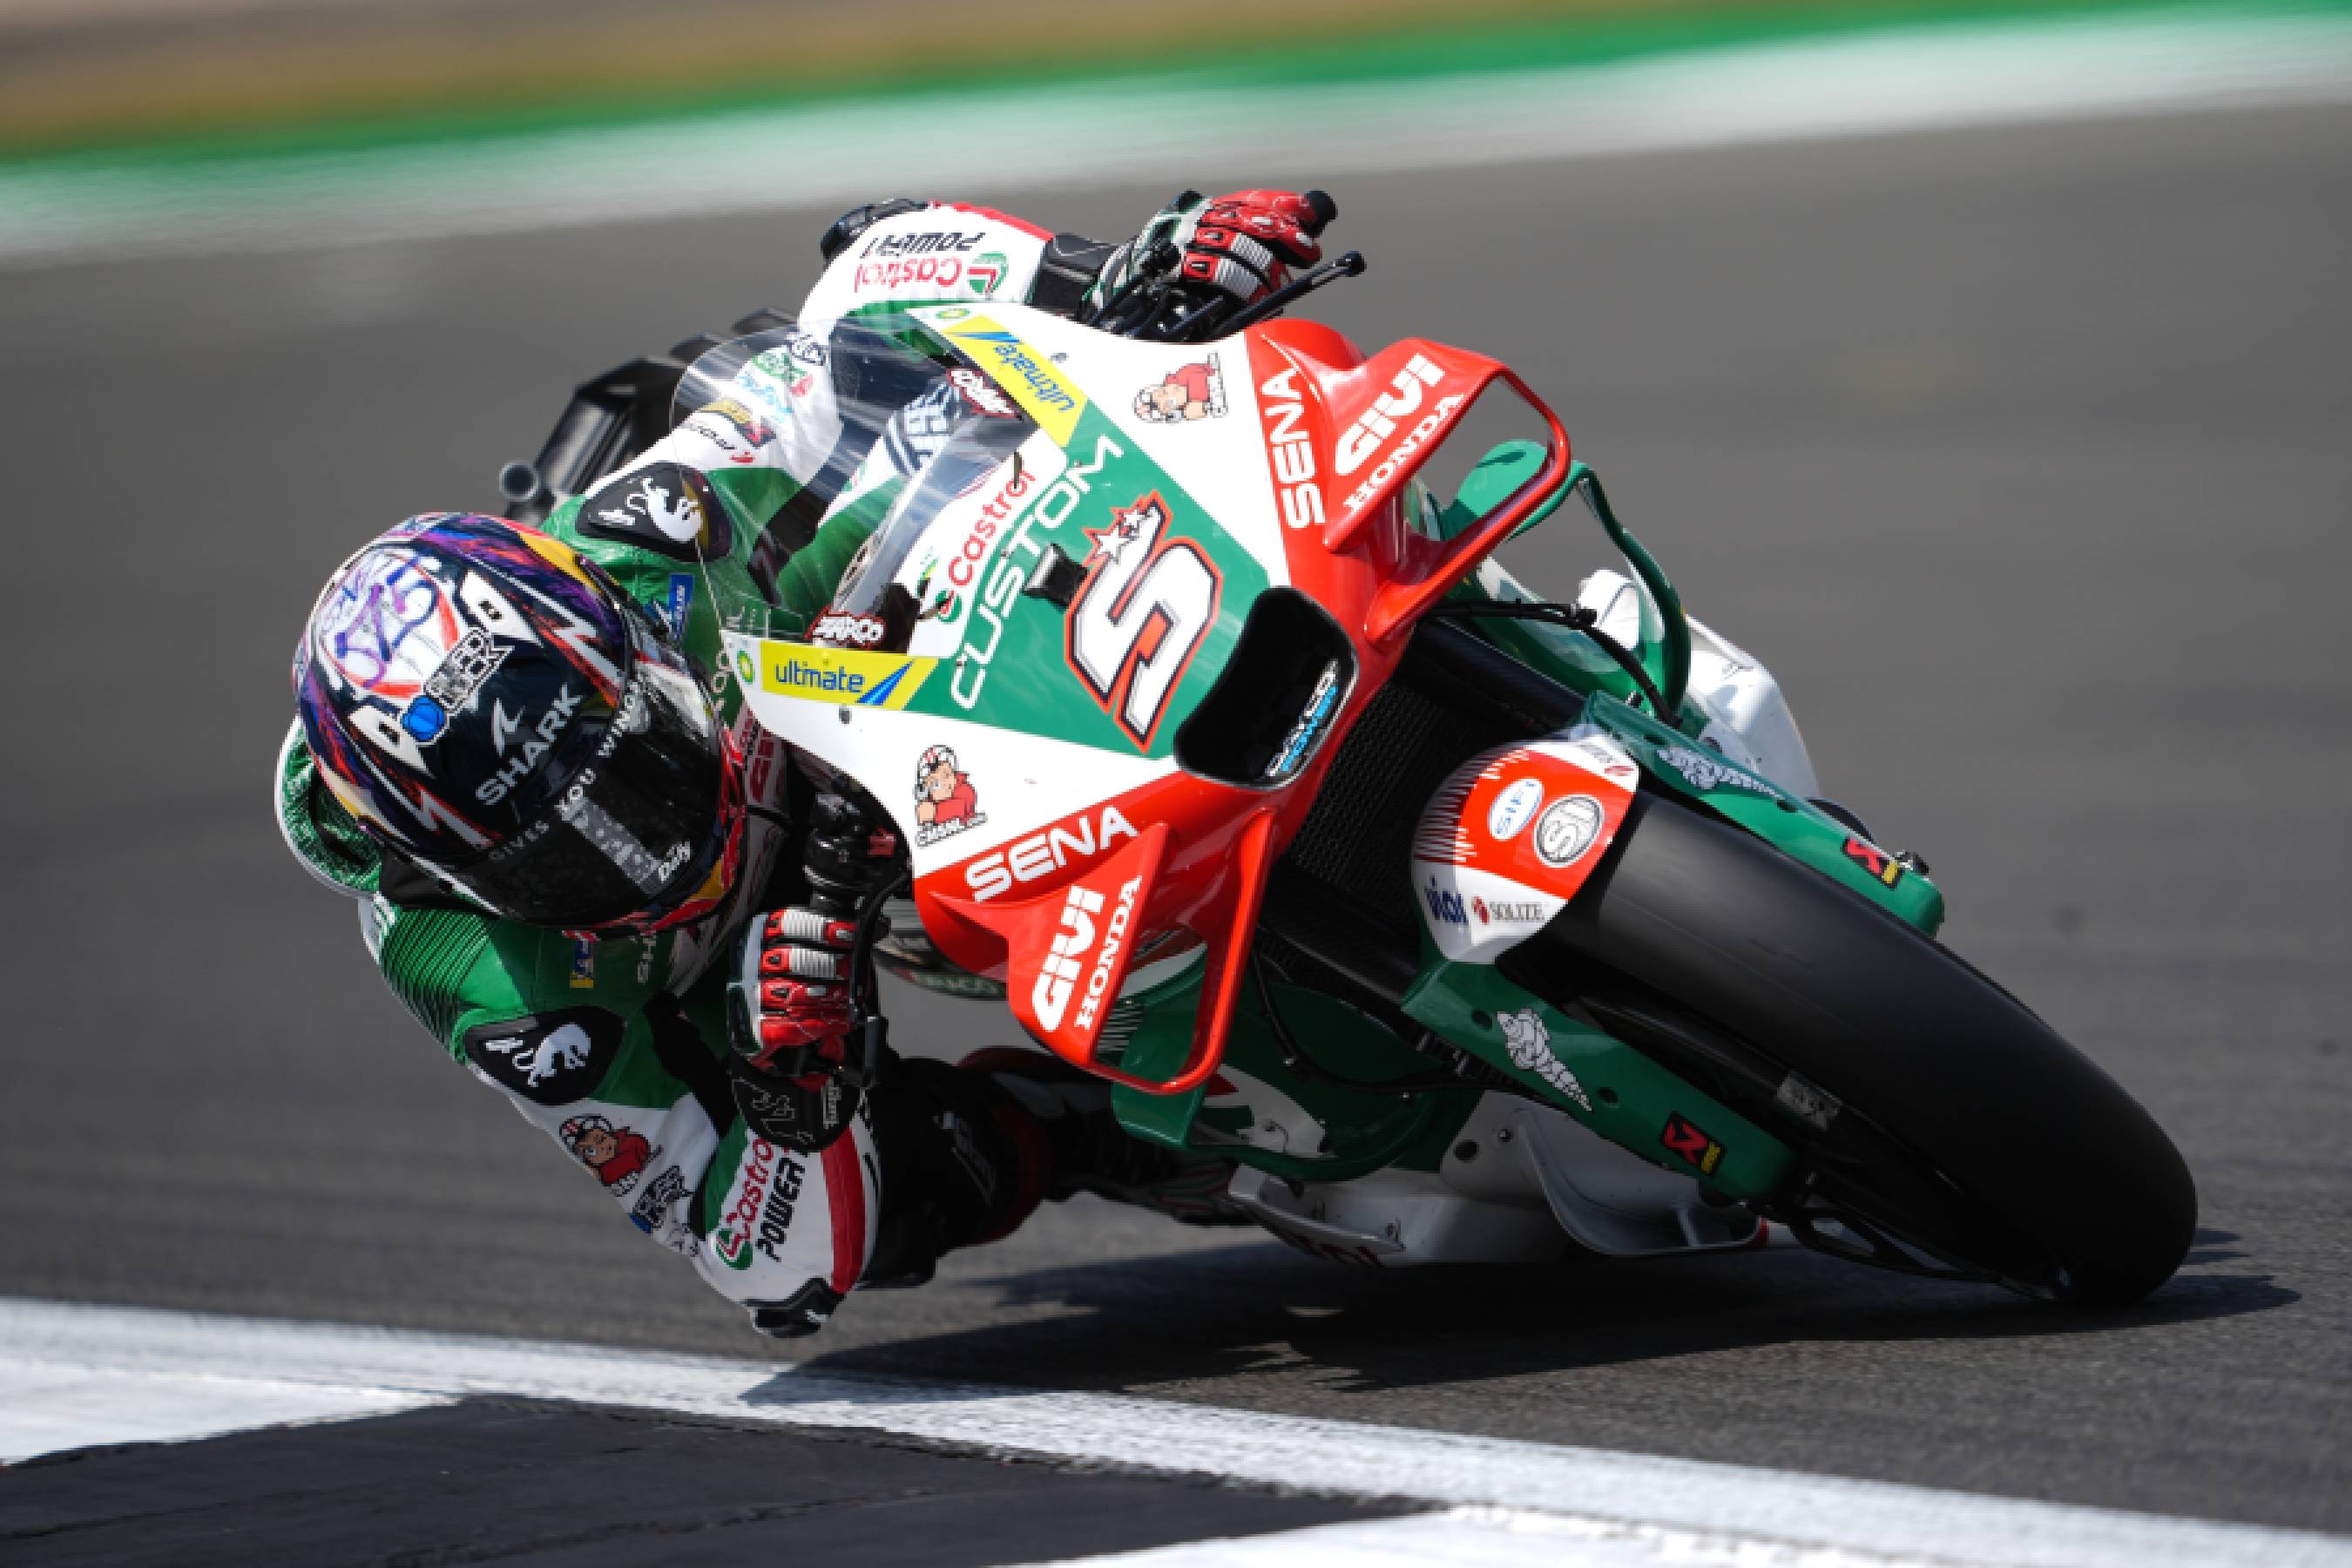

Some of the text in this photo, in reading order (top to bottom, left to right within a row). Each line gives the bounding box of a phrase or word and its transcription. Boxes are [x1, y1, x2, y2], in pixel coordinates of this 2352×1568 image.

[854, 256, 963, 294] Castrol
[993, 335, 1075, 413] ultimate
[1334, 353, 1446, 476] GIVI
[1261, 368, 1326, 530] SENA
[1343, 394, 1465, 510] HONDA
[947, 469, 1037, 588] Castrol
[952, 436, 1124, 710] CUSTOM
[774, 659, 867, 694] ultimate
[1065, 491, 1225, 756] 5
[474, 684, 585, 806] SHARK
[554, 767, 598, 824] YOU
[963, 805, 1139, 902] SENA
[1031, 884, 1106, 1032] GIVI
[1073, 875, 1143, 1031] HONDA
[725, 1138, 775, 1241] Castro
[755, 1152, 808, 1262] POWER
